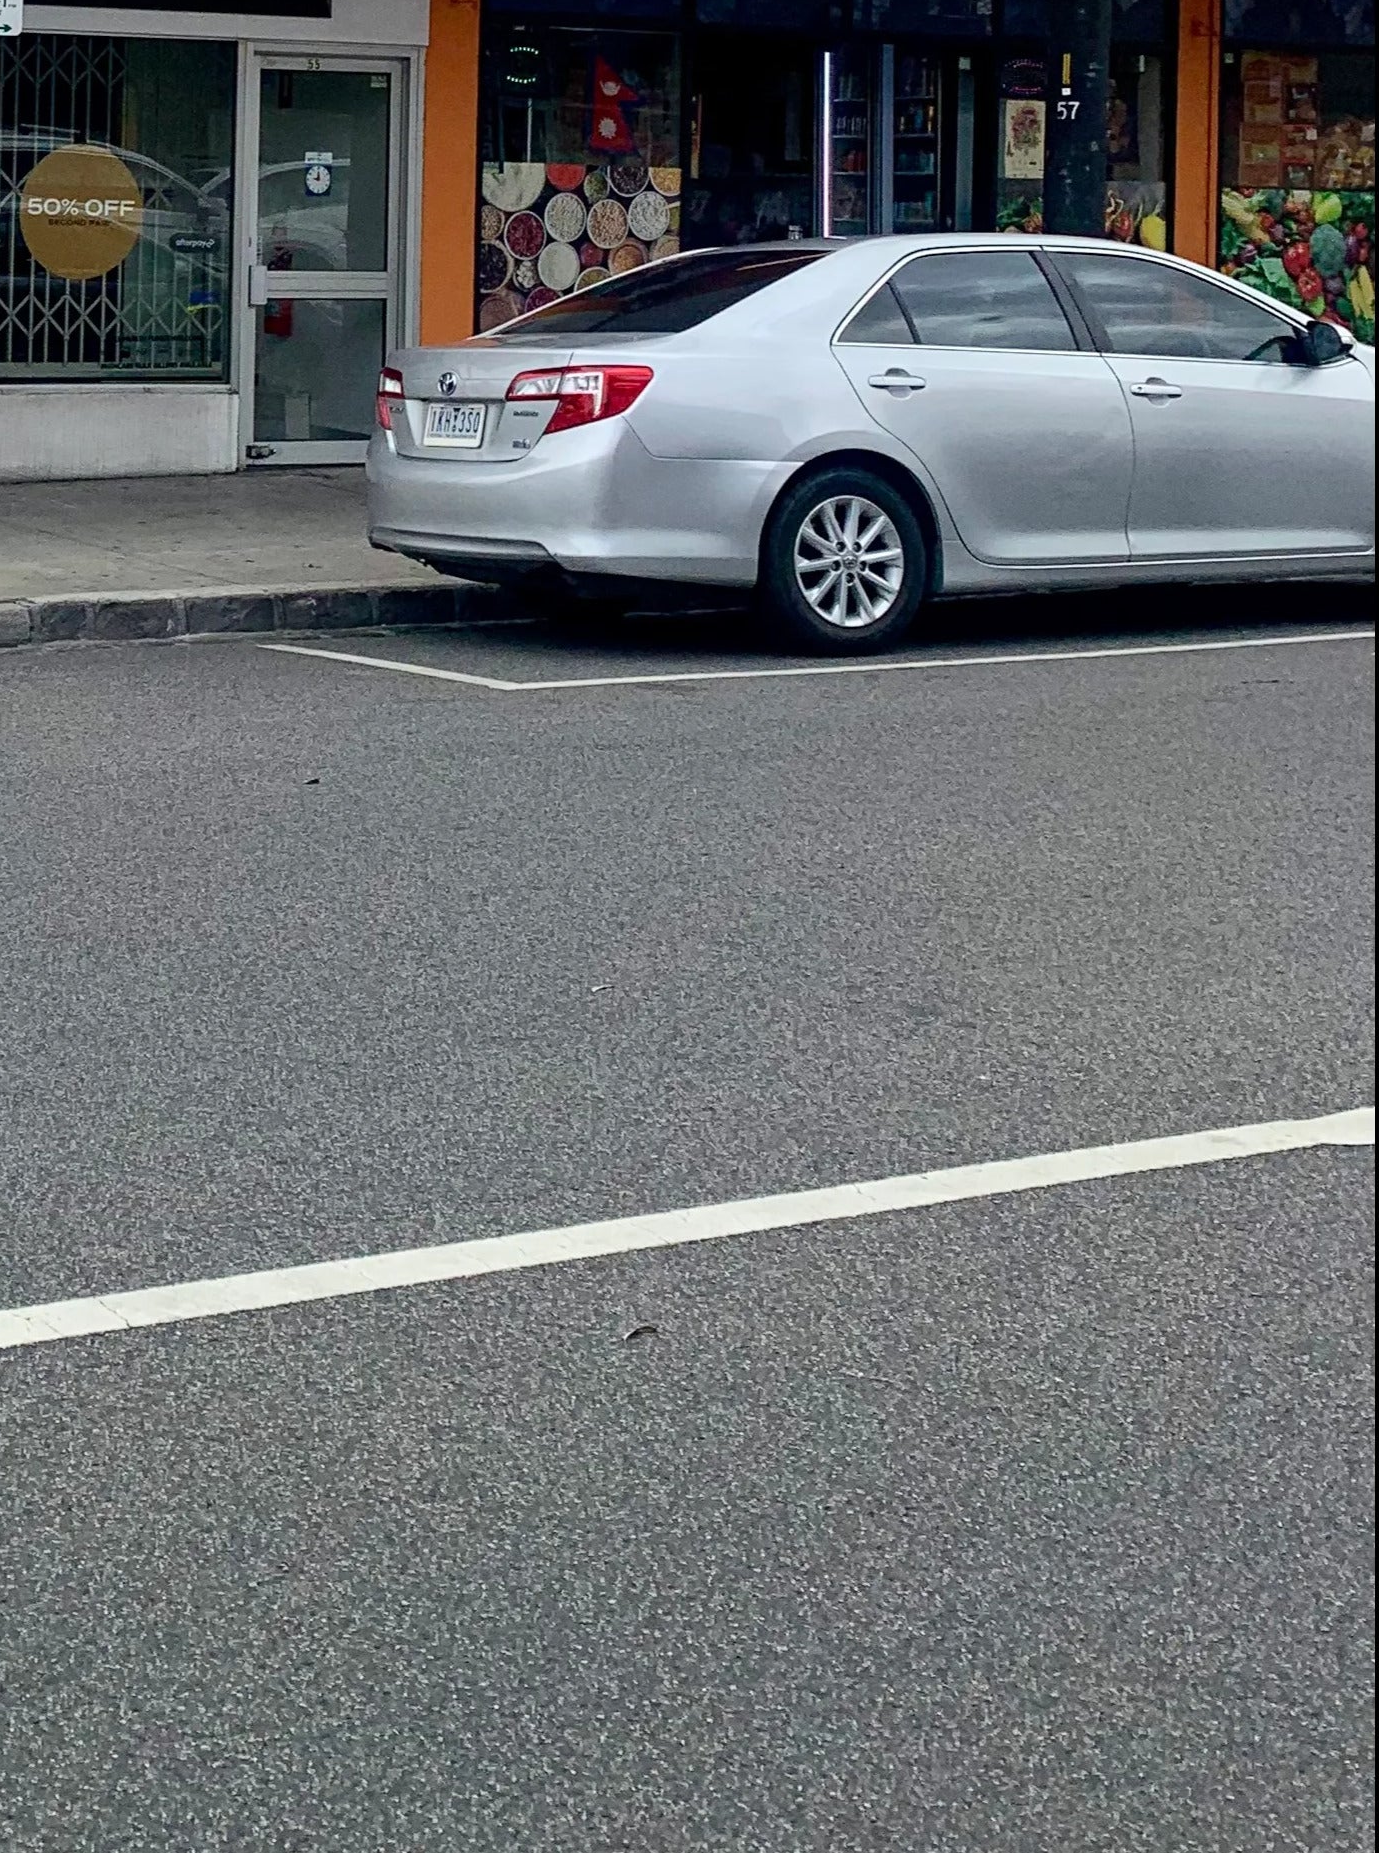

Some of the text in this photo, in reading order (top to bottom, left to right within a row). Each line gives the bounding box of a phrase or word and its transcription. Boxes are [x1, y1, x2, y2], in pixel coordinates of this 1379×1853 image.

[1057, 101, 1081, 120] 57
[27, 198, 136, 217] 50% OFF
